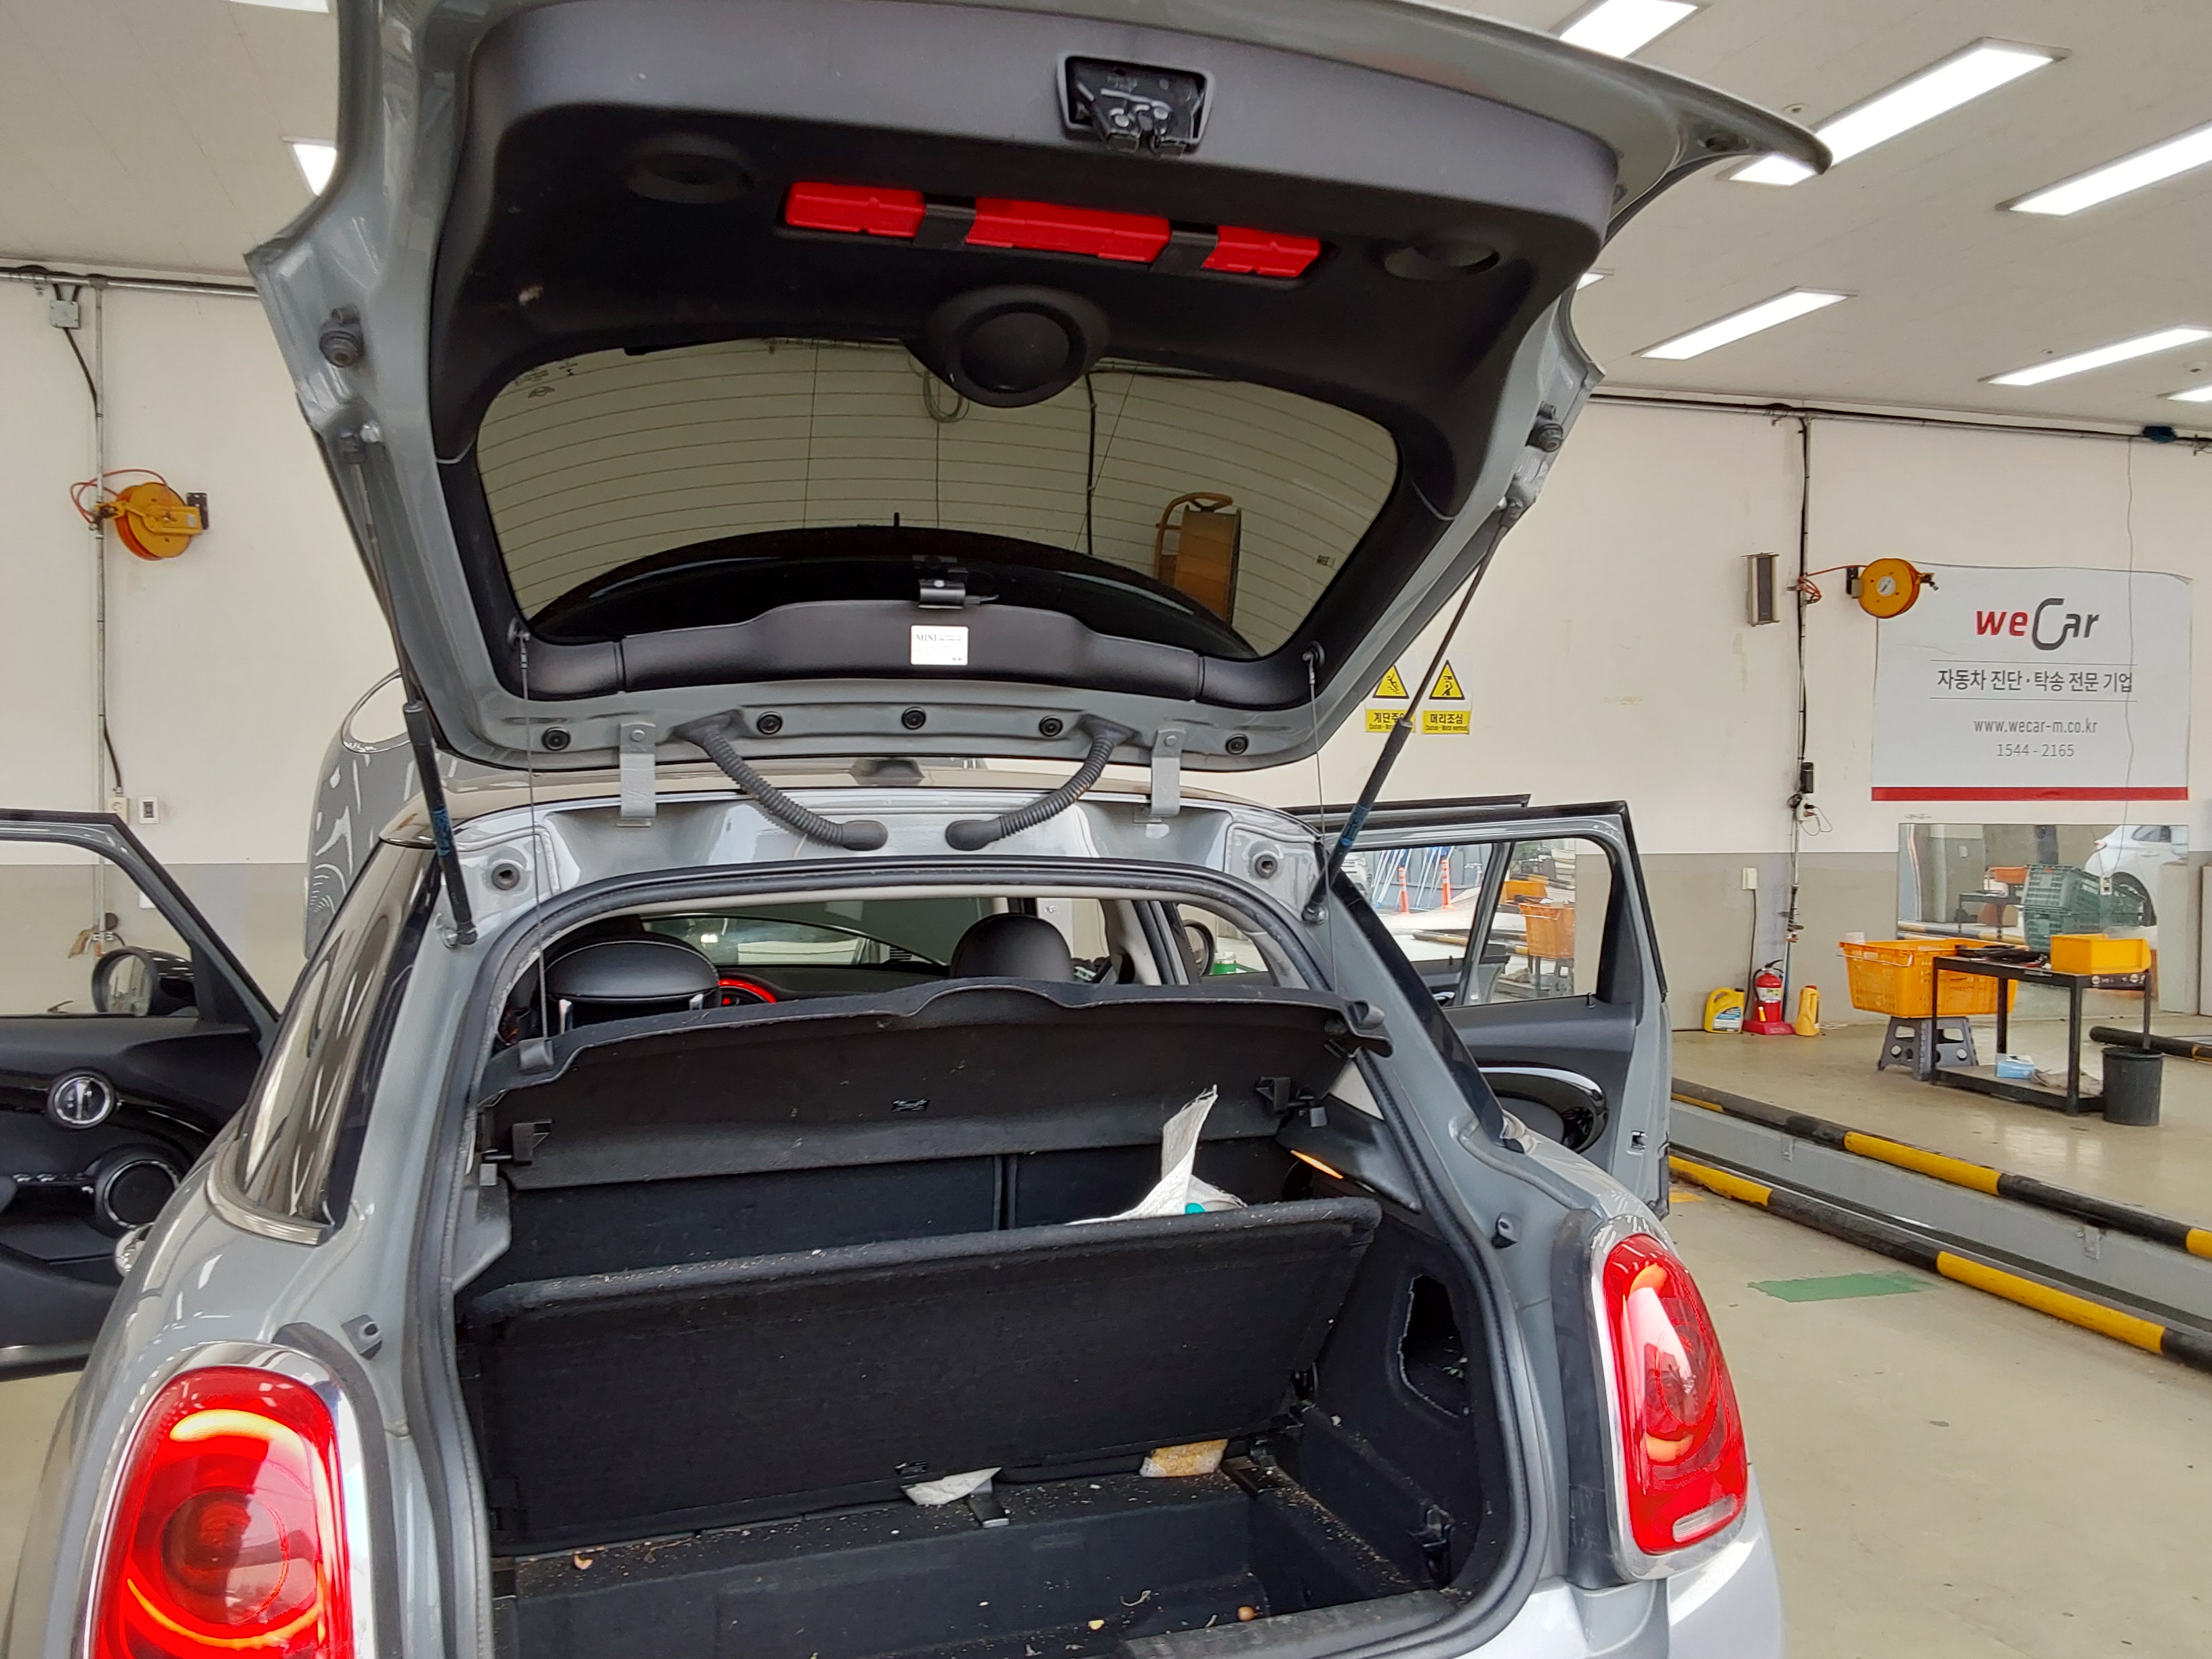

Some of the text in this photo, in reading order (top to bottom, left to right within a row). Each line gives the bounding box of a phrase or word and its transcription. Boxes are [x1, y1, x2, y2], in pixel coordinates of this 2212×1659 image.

[1938, 668, 1986, 690] 자동차
[2069, 672, 2100, 693] 전문
[2103, 672, 2133, 693] 기업
[1374, 712, 1405, 723] 계단주
[1430, 714, 1463, 724] 머리조심
[1973, 718, 2097, 733] www.wecar-m.co.kr
